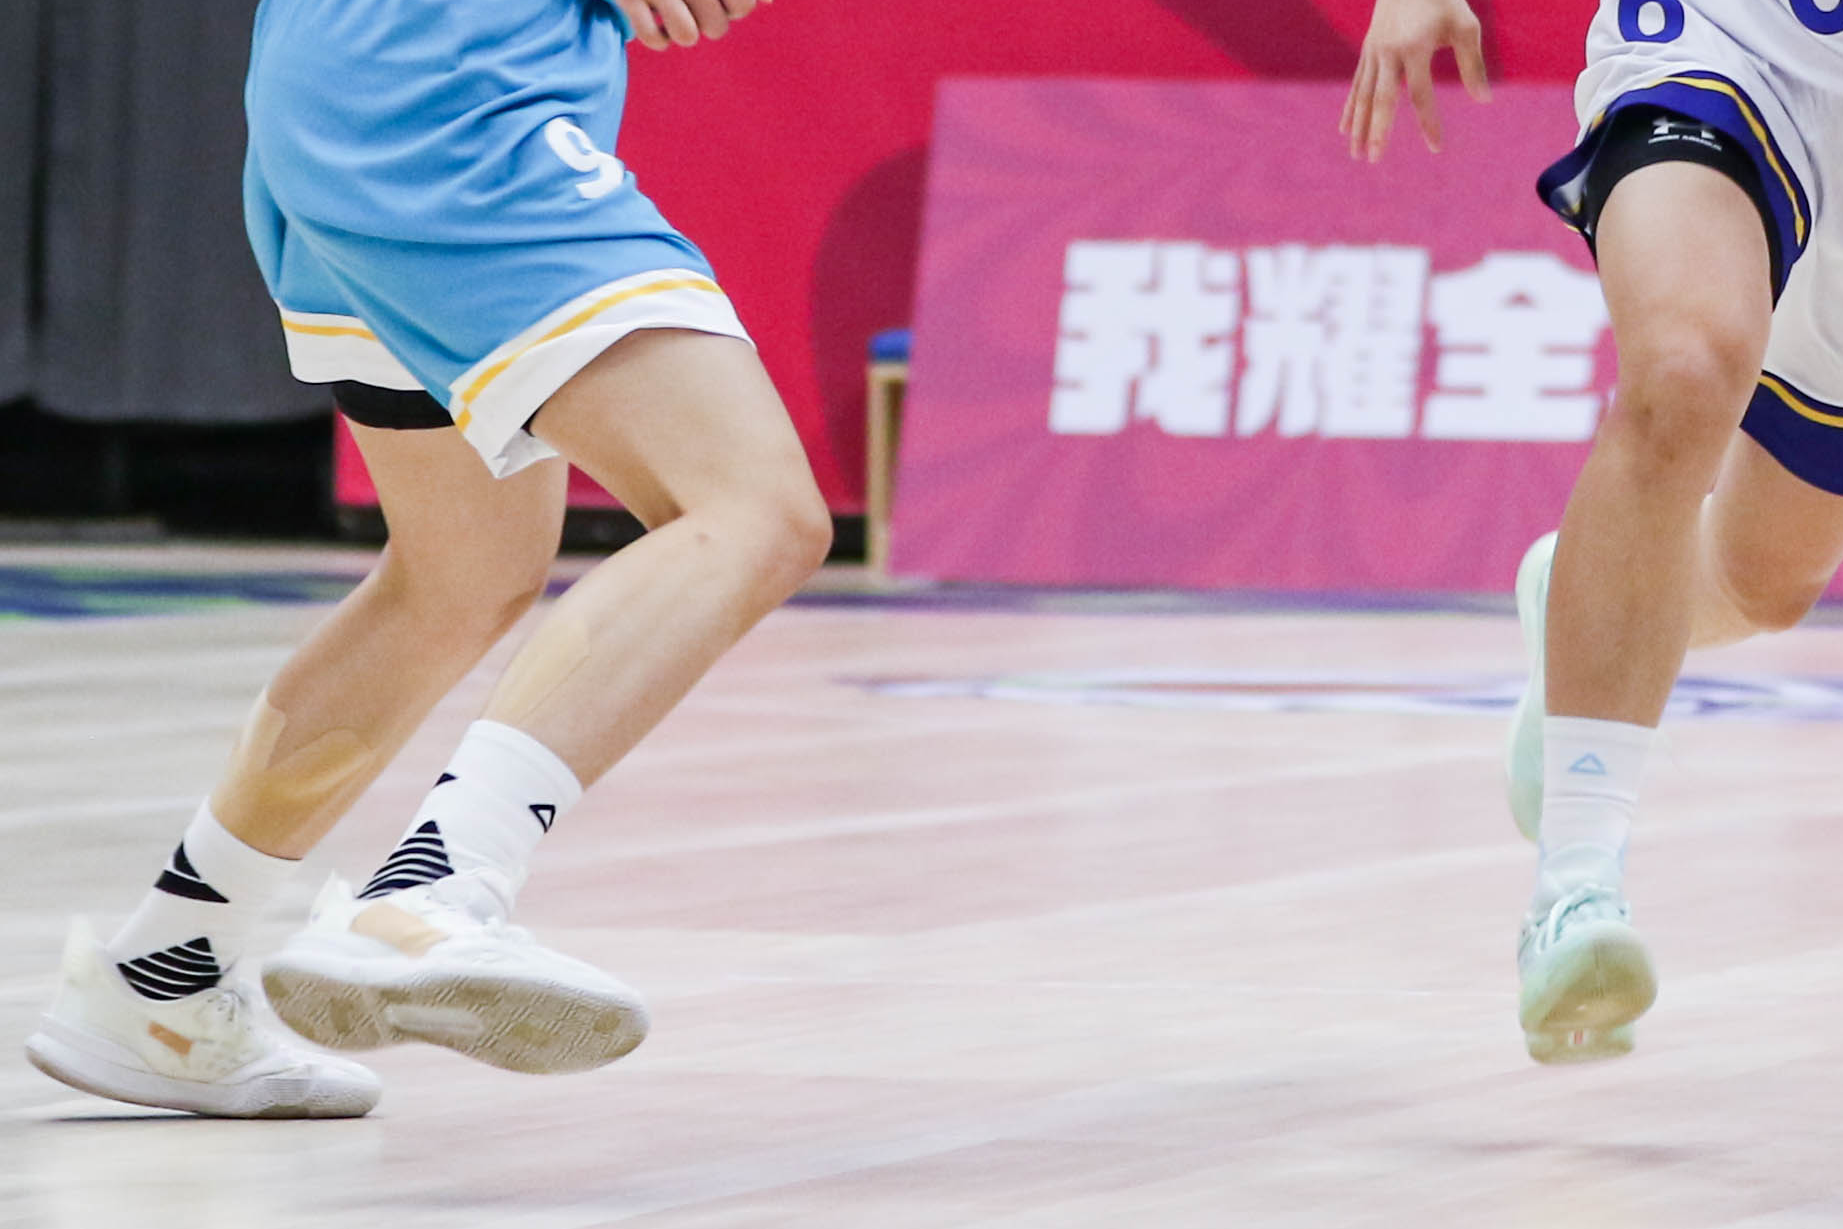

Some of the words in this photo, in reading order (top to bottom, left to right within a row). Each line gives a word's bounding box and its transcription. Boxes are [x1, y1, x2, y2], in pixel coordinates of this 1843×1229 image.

[544, 117, 624, 199] 9
[1047, 239, 1617, 442] 我耀全
